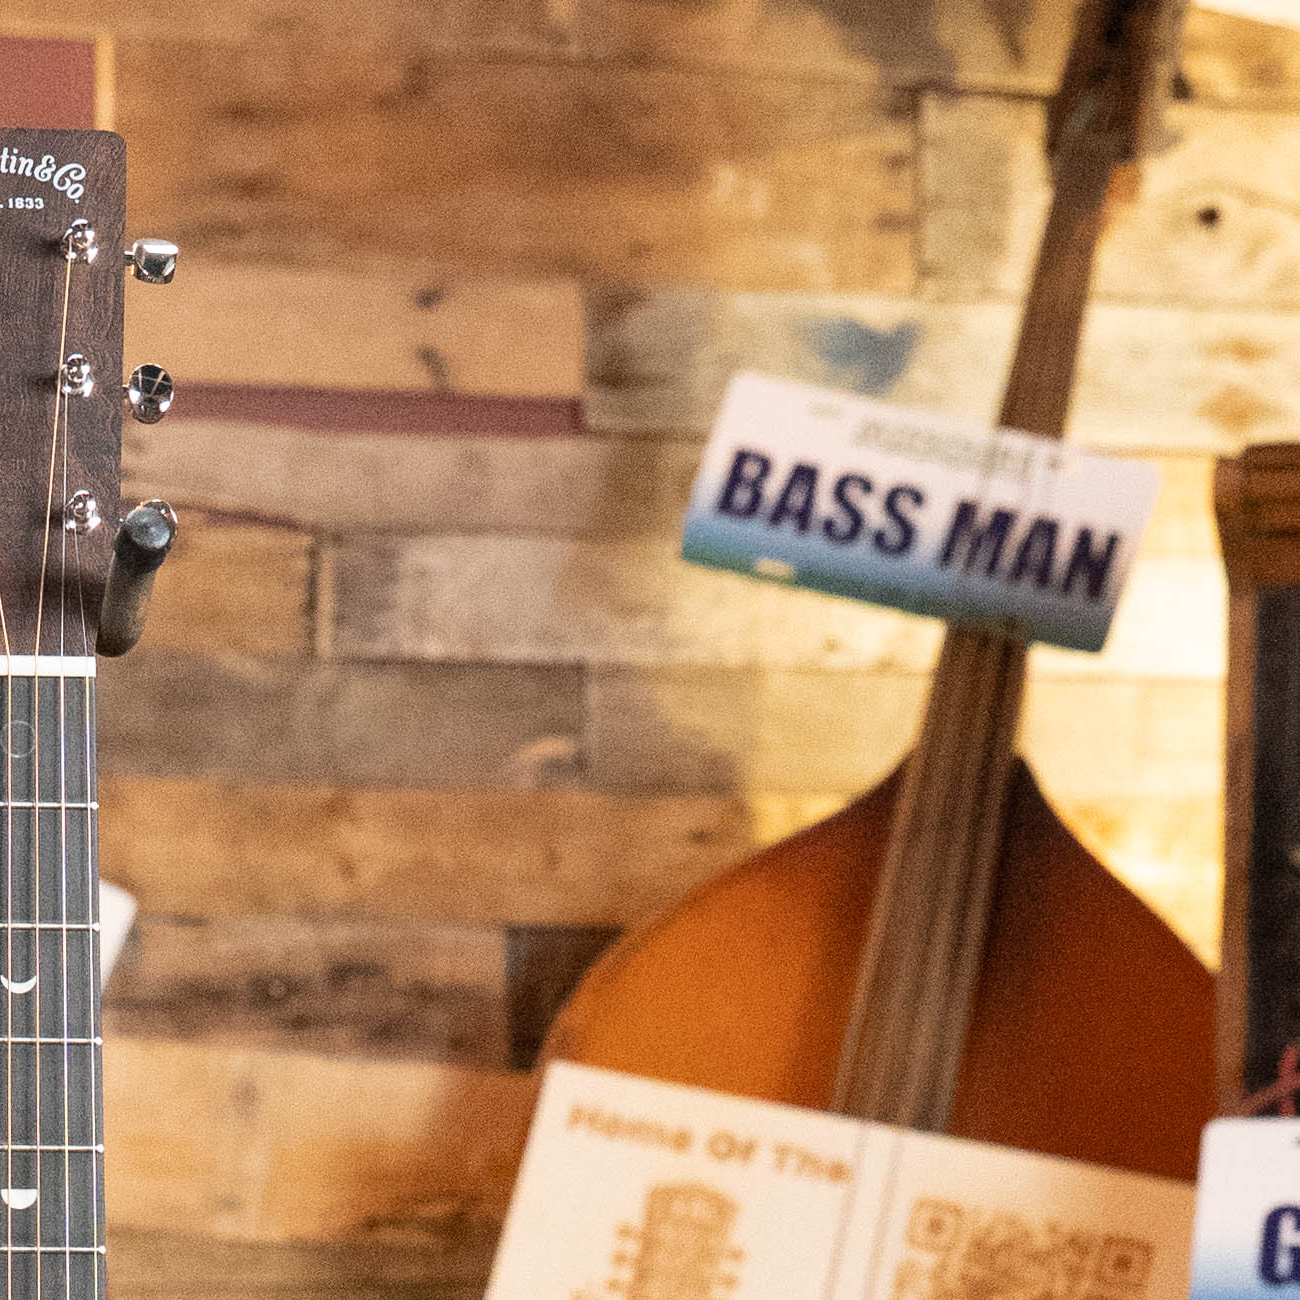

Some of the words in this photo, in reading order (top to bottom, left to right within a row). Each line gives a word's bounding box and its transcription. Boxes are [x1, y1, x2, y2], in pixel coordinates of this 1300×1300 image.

[8, 197, 45, 209] 1833
[716, 444, 926, 558] BASS
[936, 497, 1122, 602] MAN
[772, 1142, 854, 1185] The
